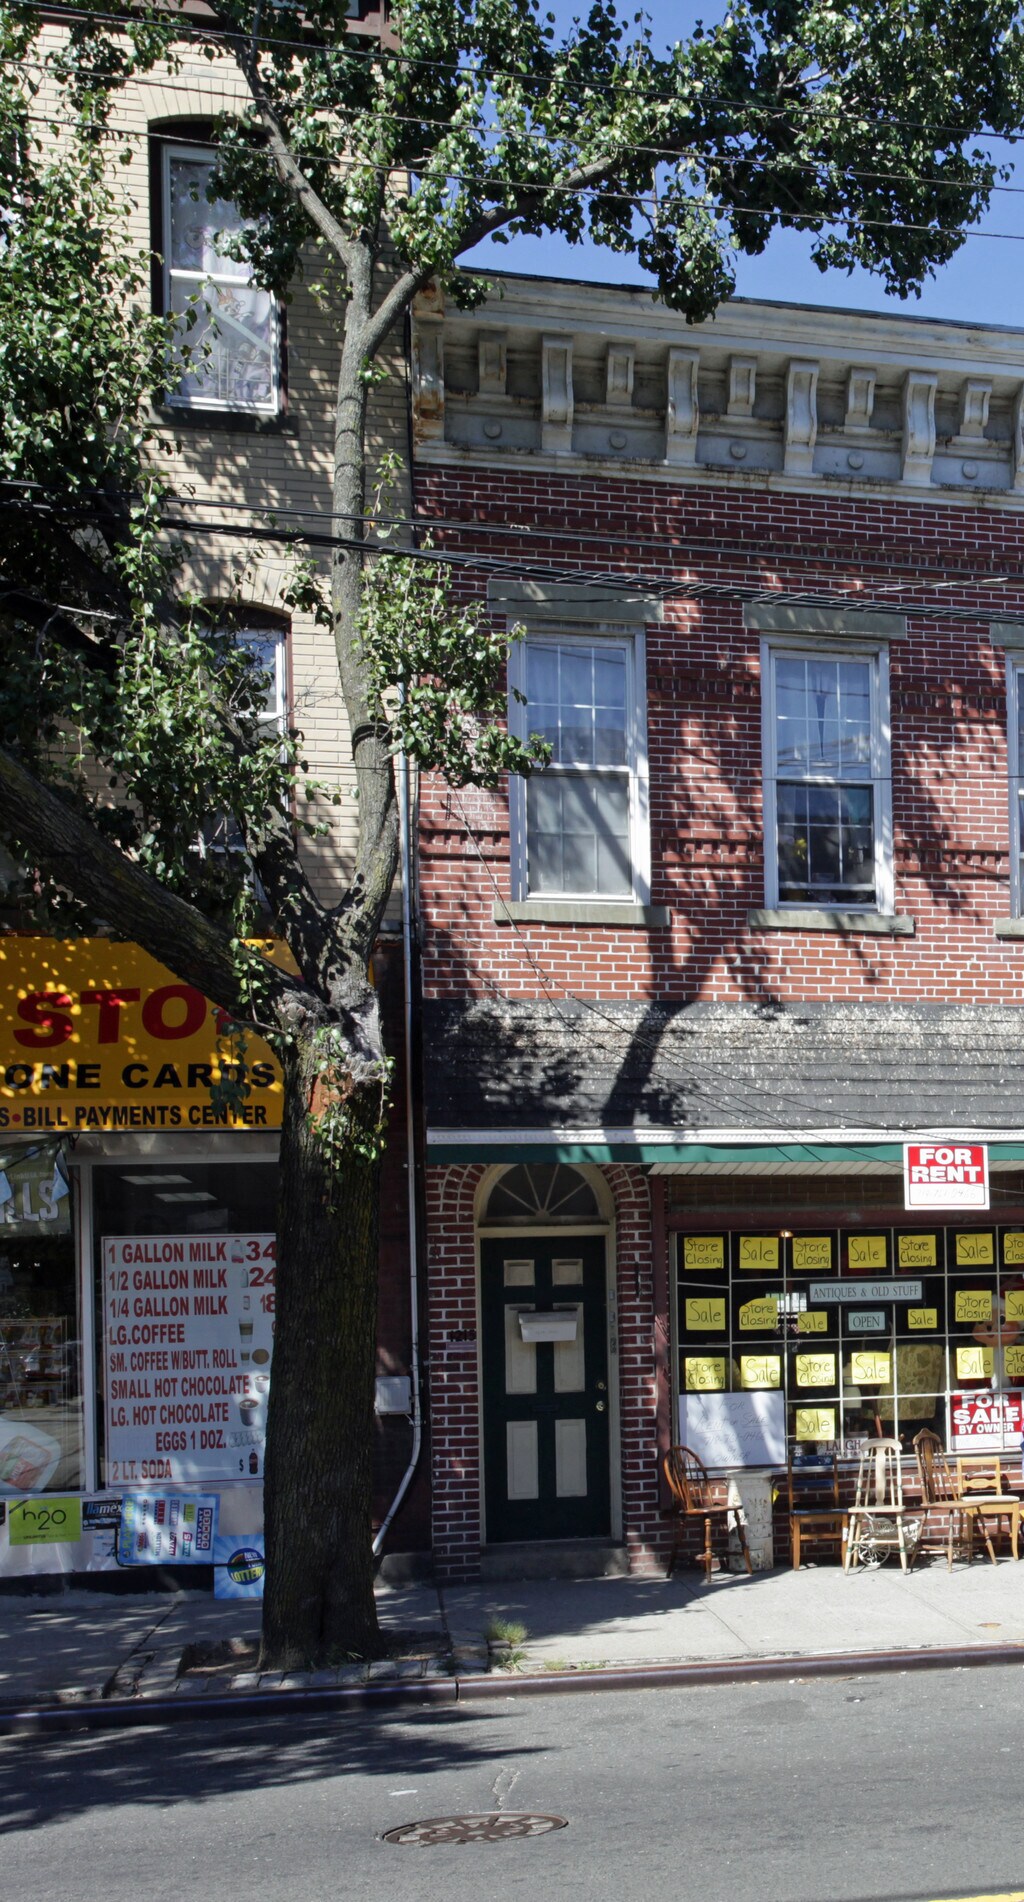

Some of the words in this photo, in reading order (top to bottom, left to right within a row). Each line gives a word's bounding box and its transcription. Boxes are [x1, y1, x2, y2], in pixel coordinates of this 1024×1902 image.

[24, 1107, 68, 1127] BILL
[75, 1105, 181, 1126] PAYMENTS
[919, 1147, 973, 1165] FOR
[911, 1165, 981, 1183] RENT
[109, 1243, 116, 1263] 1
[122, 1242, 184, 1263] GALLON
[189, 1242, 227, 1262] MILK
[687, 1238, 719, 1252] Store
[741, 1239, 775, 1262] Sale
[794, 1239, 828, 1252] Store
[849, 1238, 879, 1262] Sale
[900, 1236, 930, 1251] Store
[957, 1236, 990, 1259] Sale
[685, 1252, 723, 1268] Closing
[795, 1252, 830, 1268] Closing
[900, 1251, 933, 1264] Closing
[109, 1270, 129, 1291] 1/2
[132, 1270, 189, 1290] GALLON
[193, 1268, 227, 1289] MILK
[813, 1287, 857, 1300] ANTIQUES
[860, 1289, 867, 1298] &
[871, 1286, 889, 1297] OLD
[892, 1285, 918, 1297] STUFF
[957, 1291, 990, 1308] Store
[109, 1297, 129, 1318] 1/4
[133, 1297, 189, 1318] GALLON
[194, 1295, 228, 1316] MILK
[688, 1301, 722, 1323] Sale
[741, 1302, 775, 1314] Store
[956, 1308, 991, 1322] Closing
[798, 1312, 824, 1330] Sale
[852, 1315, 880, 1328] OPEN
[909, 1310, 934, 1325] Sale
[110, 1350, 128, 1373] SM.
[130, 1350, 169, 1372] COFFEE
[170, 1349, 209, 1371] W/BUTT.
[212, 1348, 238, 1369] ROLL
[687, 1358, 721, 1372] Store
[798, 1356, 832, 1372] Store
[852, 1354, 886, 1380] Sale
[959, 1350, 991, 1374] Sale
[745, 1358, 779, 1384] Sale
[110, 1378, 151, 1400] SMALL
[154, 1377, 178, 1398] HOT
[181, 1375, 250, 1397] CHOCOLATE
[961, 1394, 1010, 1409] FOR
[110, 1407, 129, 1427] LG.
[133, 1405, 157, 1426] HOT
[160, 1402, 230, 1425] CHOCOLATE
[799, 1410, 830, 1433] Sale
[953, 1407, 1020, 1425] SALE
[958, 1424, 973, 1434] BY
[976, 1422, 1015, 1434] OWNER
[155, 1431, 187, 1452] EGGS
[190, 1431, 197, 1450] 1
[200, 1430, 227, 1449] DOZ.
[112, 1461, 119, 1481] 2
[122, 1460, 138, 1481] LT.
[141, 1459, 173, 1479] SODA
